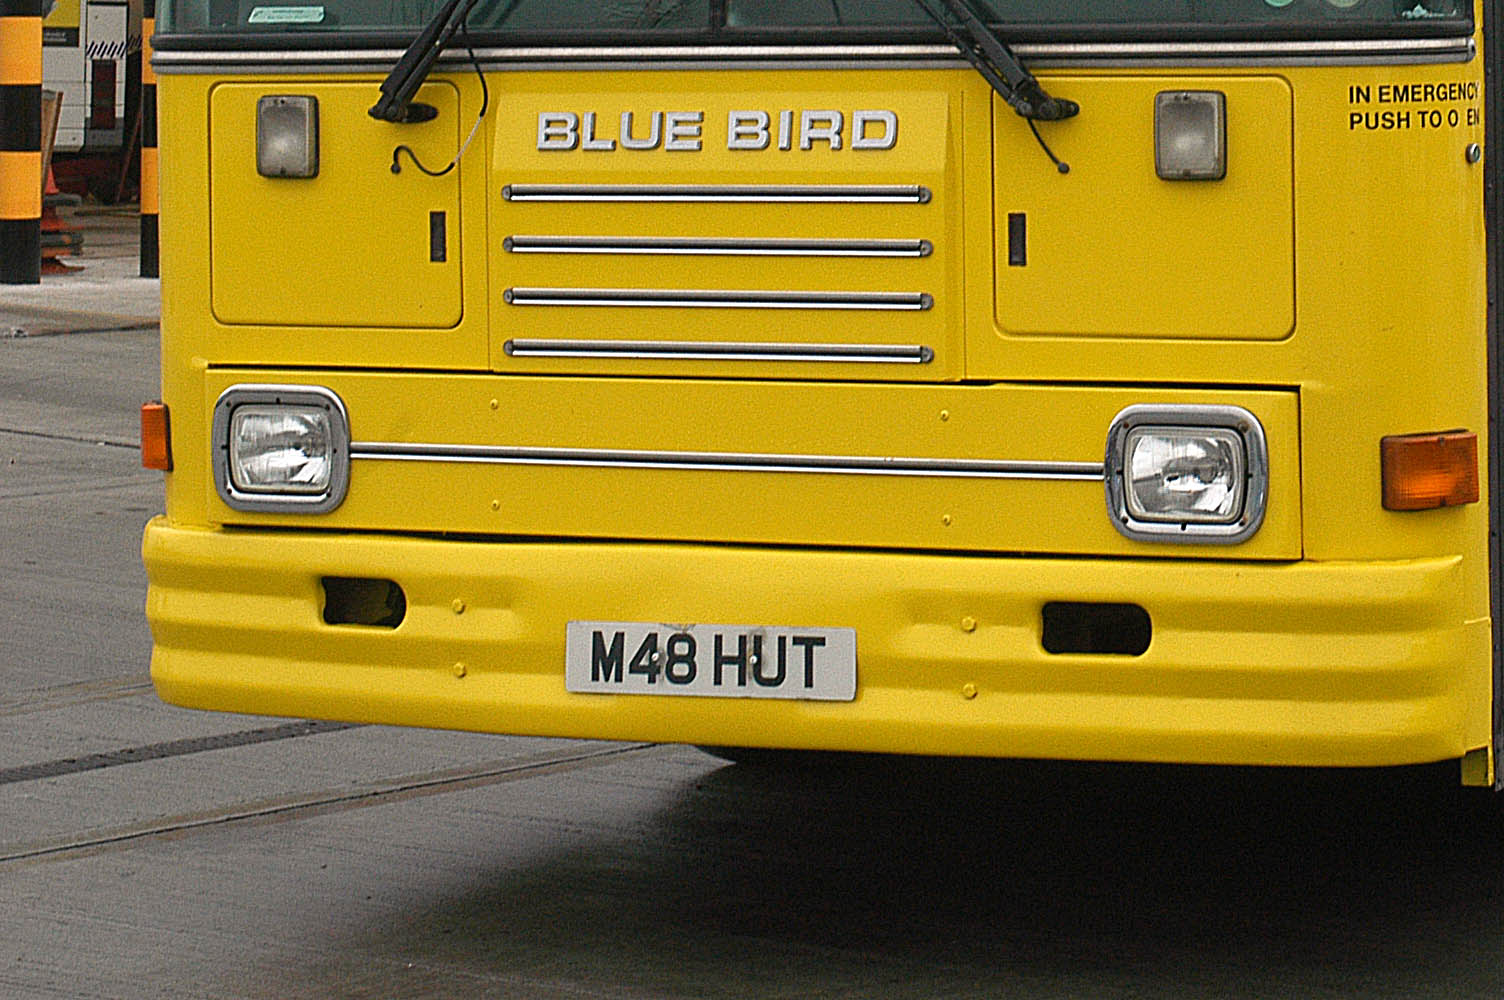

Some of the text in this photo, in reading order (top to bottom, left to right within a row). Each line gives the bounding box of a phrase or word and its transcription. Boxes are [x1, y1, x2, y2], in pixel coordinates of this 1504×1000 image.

[1349, 82, 1480, 105] IN EMERGENCY
[536, 108, 899, 152] BLUE BIRD
[1349, 110, 1411, 131] PUSH
[1417, 109, 1442, 129] TO
[591, 630, 827, 689] M48 HUT
